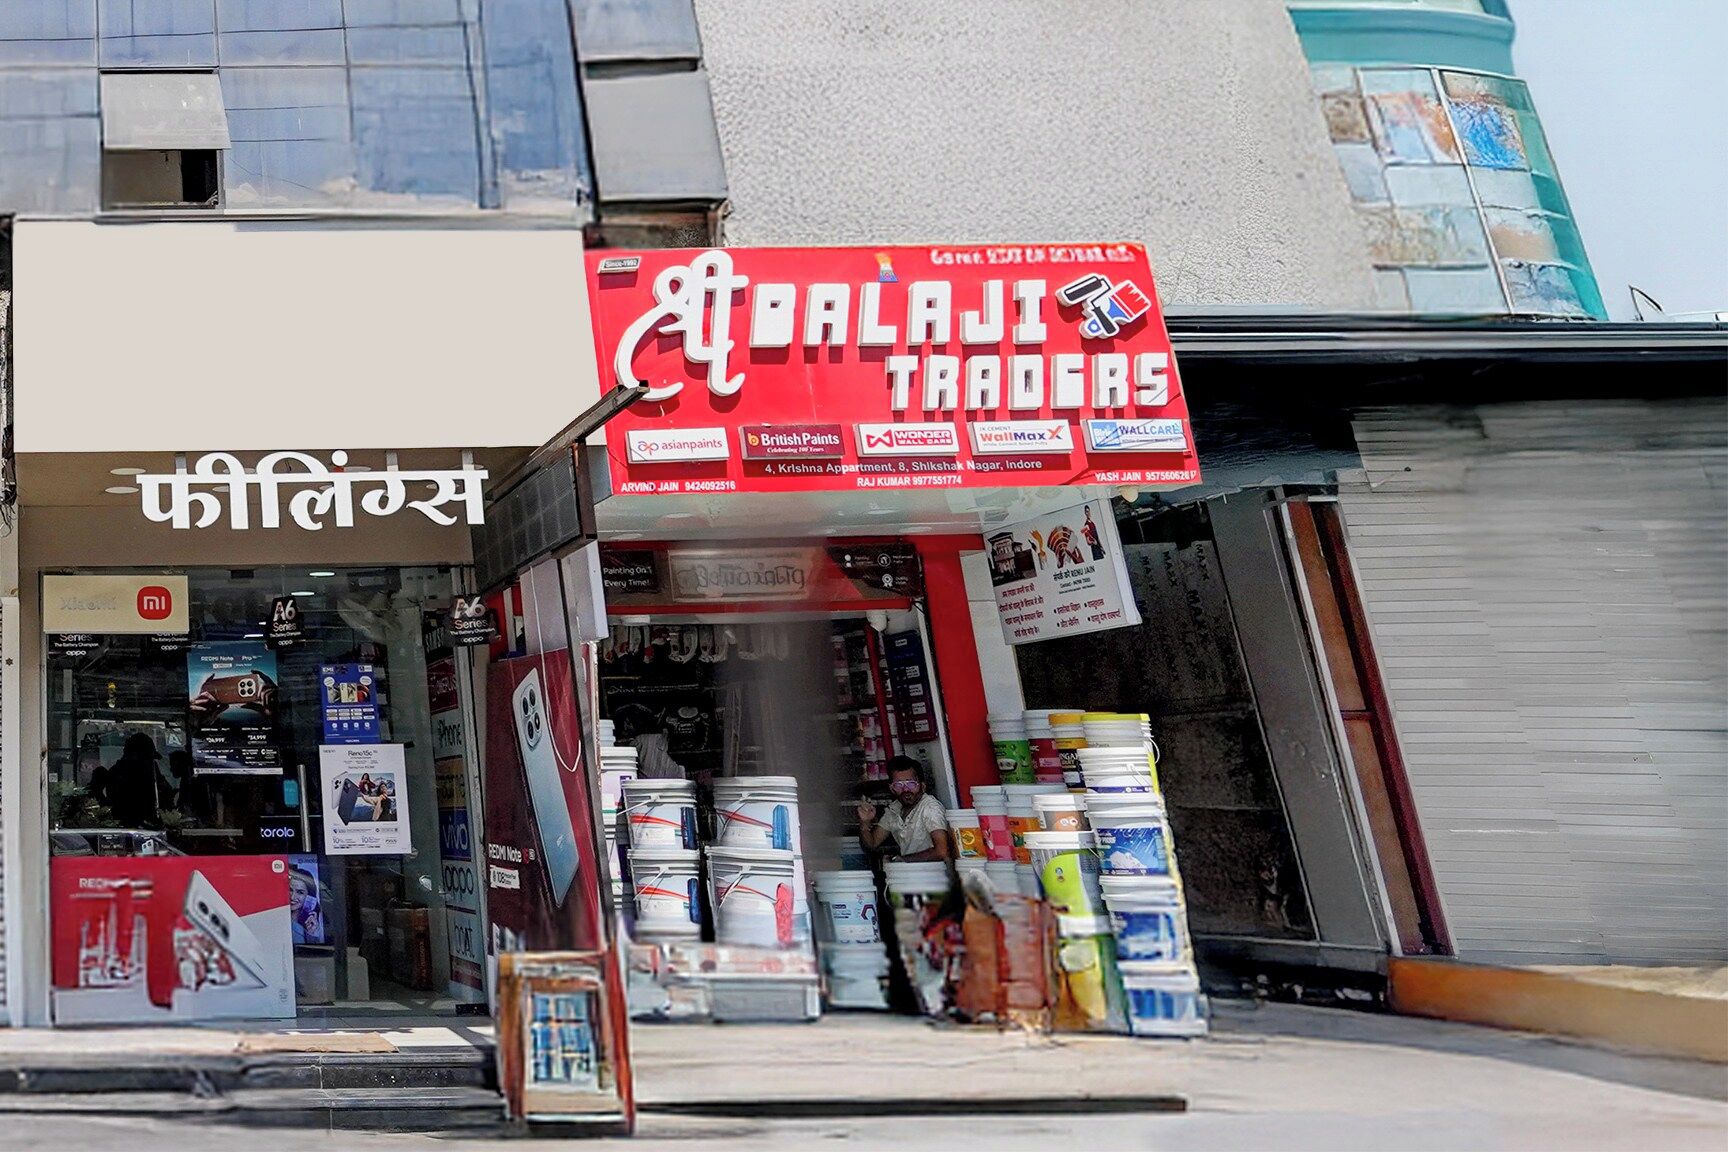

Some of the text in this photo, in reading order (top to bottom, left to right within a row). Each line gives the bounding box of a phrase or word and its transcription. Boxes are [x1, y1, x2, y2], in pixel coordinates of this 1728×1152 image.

[749, 279, 1047, 348] BALAJI
[614, 250, 749, 401] श्री
[761, 432, 840, 446] British Paints
[895, 430, 952, 439] WONDER
[661, 438, 723, 453] asianpaints
[778, 462, 823, 474] Krishna
[825, 462, 897, 475] Appartment,
[899, 461, 909, 472] 8,
[912, 460, 964, 472] Shikshak
[967, 460, 1004, 472] Nagar,
[1006, 459, 1042, 470] Indore
[857, 477, 876, 487] RAJ
[877, 476, 911, 486] KUMAR
[1095, 472, 1142, 481] YASH JAIN
[136, 449, 489, 531] फीलिंग्स
[621, 481, 656, 491] ARVIND
[657, 481, 679, 491] JAIN
[603, 567, 635, 576] Painting
[604, 580, 627, 589] Every
[273, 599, 297, 622] A6
[454, 596, 487, 619] A6
[273, 621, 297, 632] Series
[454, 619, 488, 630] Series
[442, 823, 470, 850] vivo
